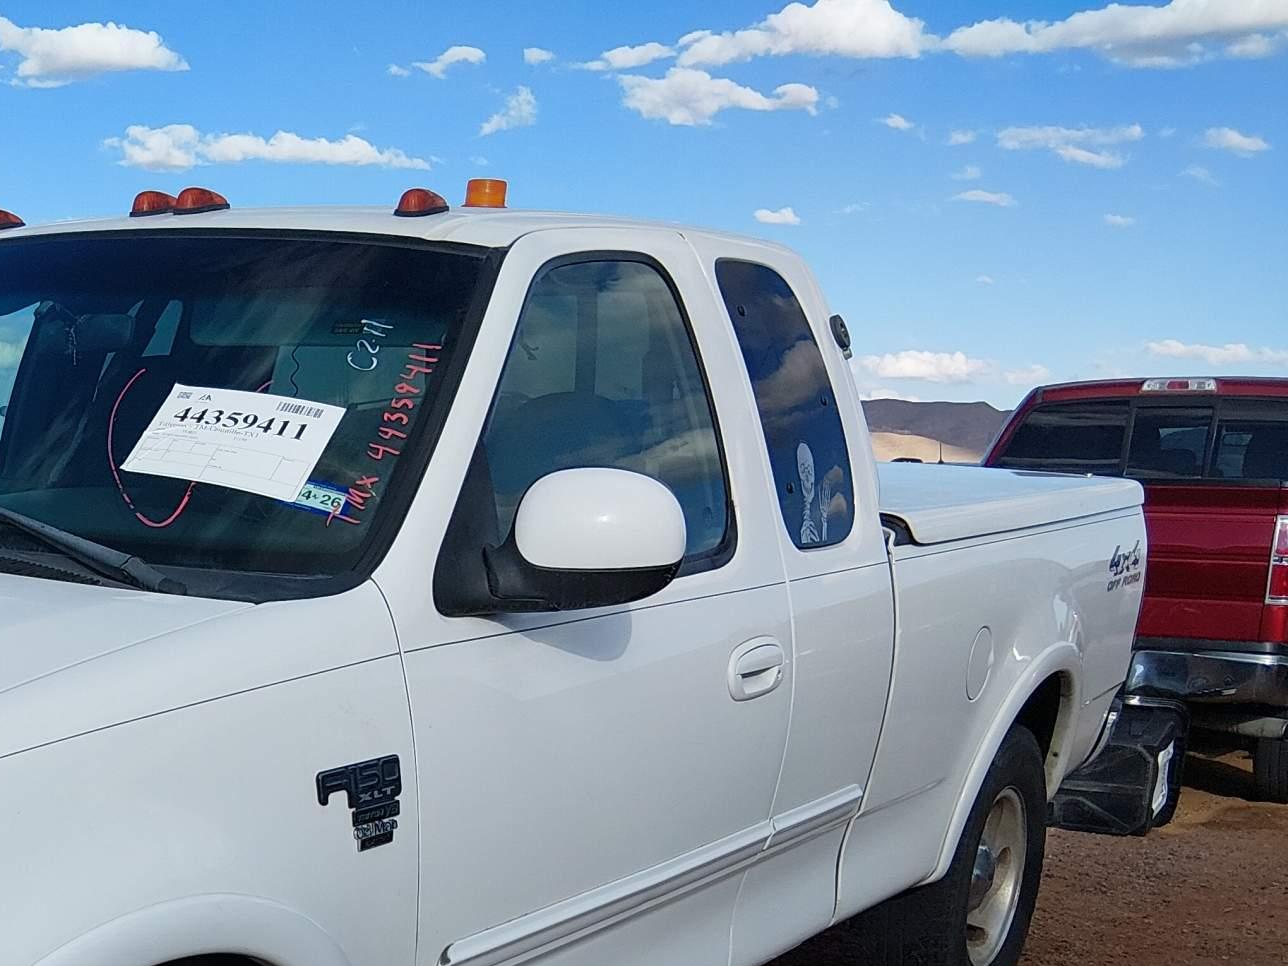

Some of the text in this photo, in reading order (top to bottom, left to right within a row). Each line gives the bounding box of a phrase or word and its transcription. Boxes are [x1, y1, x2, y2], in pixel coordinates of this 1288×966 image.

[368, 343, 443, 461] 44359411
[173, 406, 308, 441] 44359411
[358, 785, 396, 803] XLT
